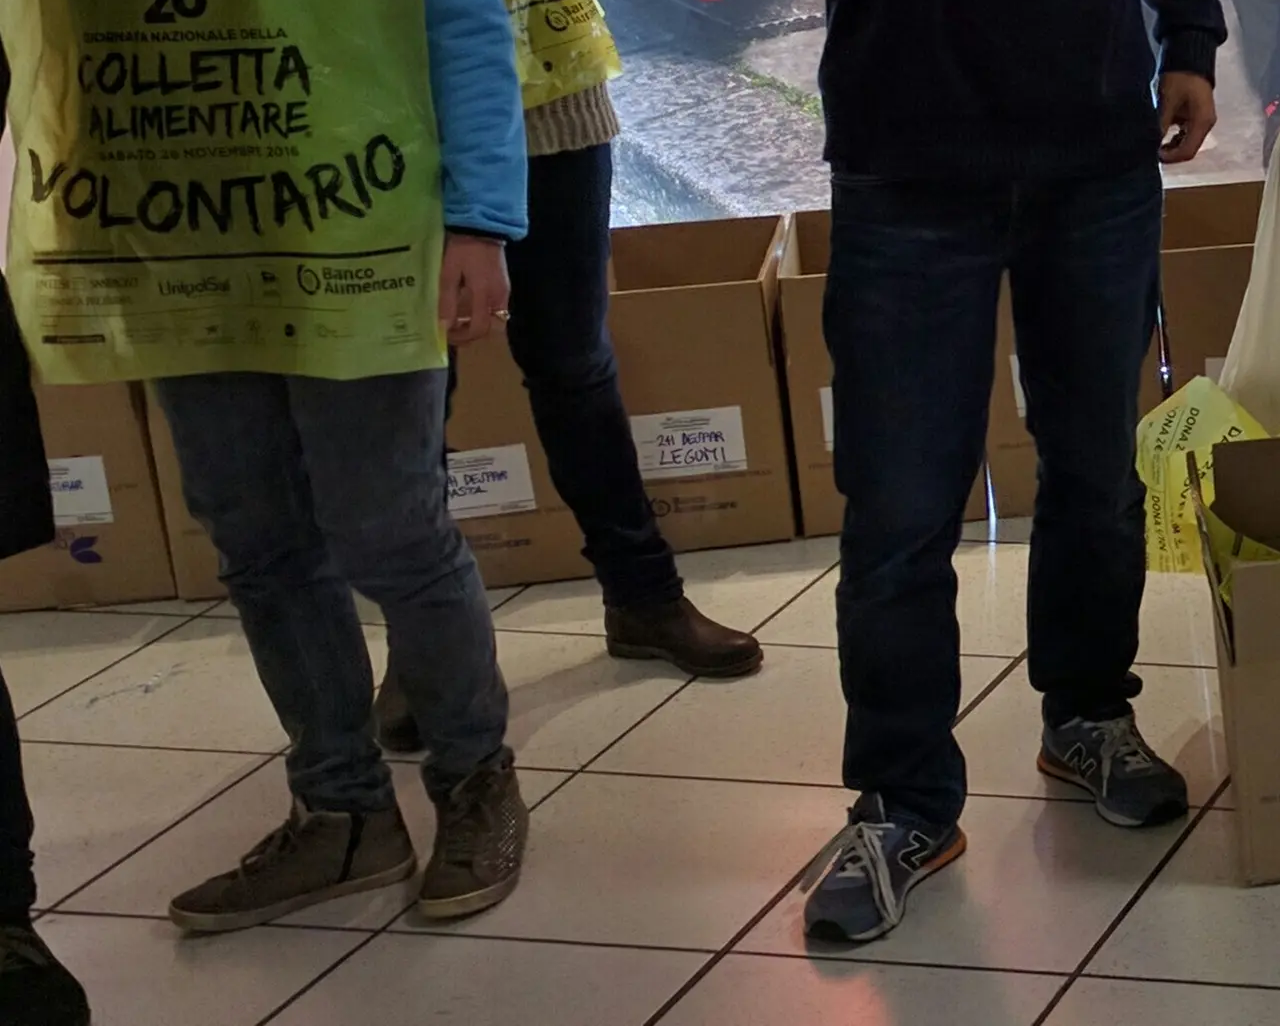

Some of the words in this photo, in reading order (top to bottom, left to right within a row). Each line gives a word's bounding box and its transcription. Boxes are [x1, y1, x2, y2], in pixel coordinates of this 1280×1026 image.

[151, 29, 237, 43] NAZIONALE
[239, 27, 286, 40] DELLA
[77, 45, 311, 97] COLLETTA
[88, 100, 309, 144] ALIMENTARE
[27, 133, 406, 236] VOLONTARIO
[321, 265, 375, 281] Banco
[324, 275, 416, 296] Alimentare
[658, 447, 727, 466] LEGUMI
